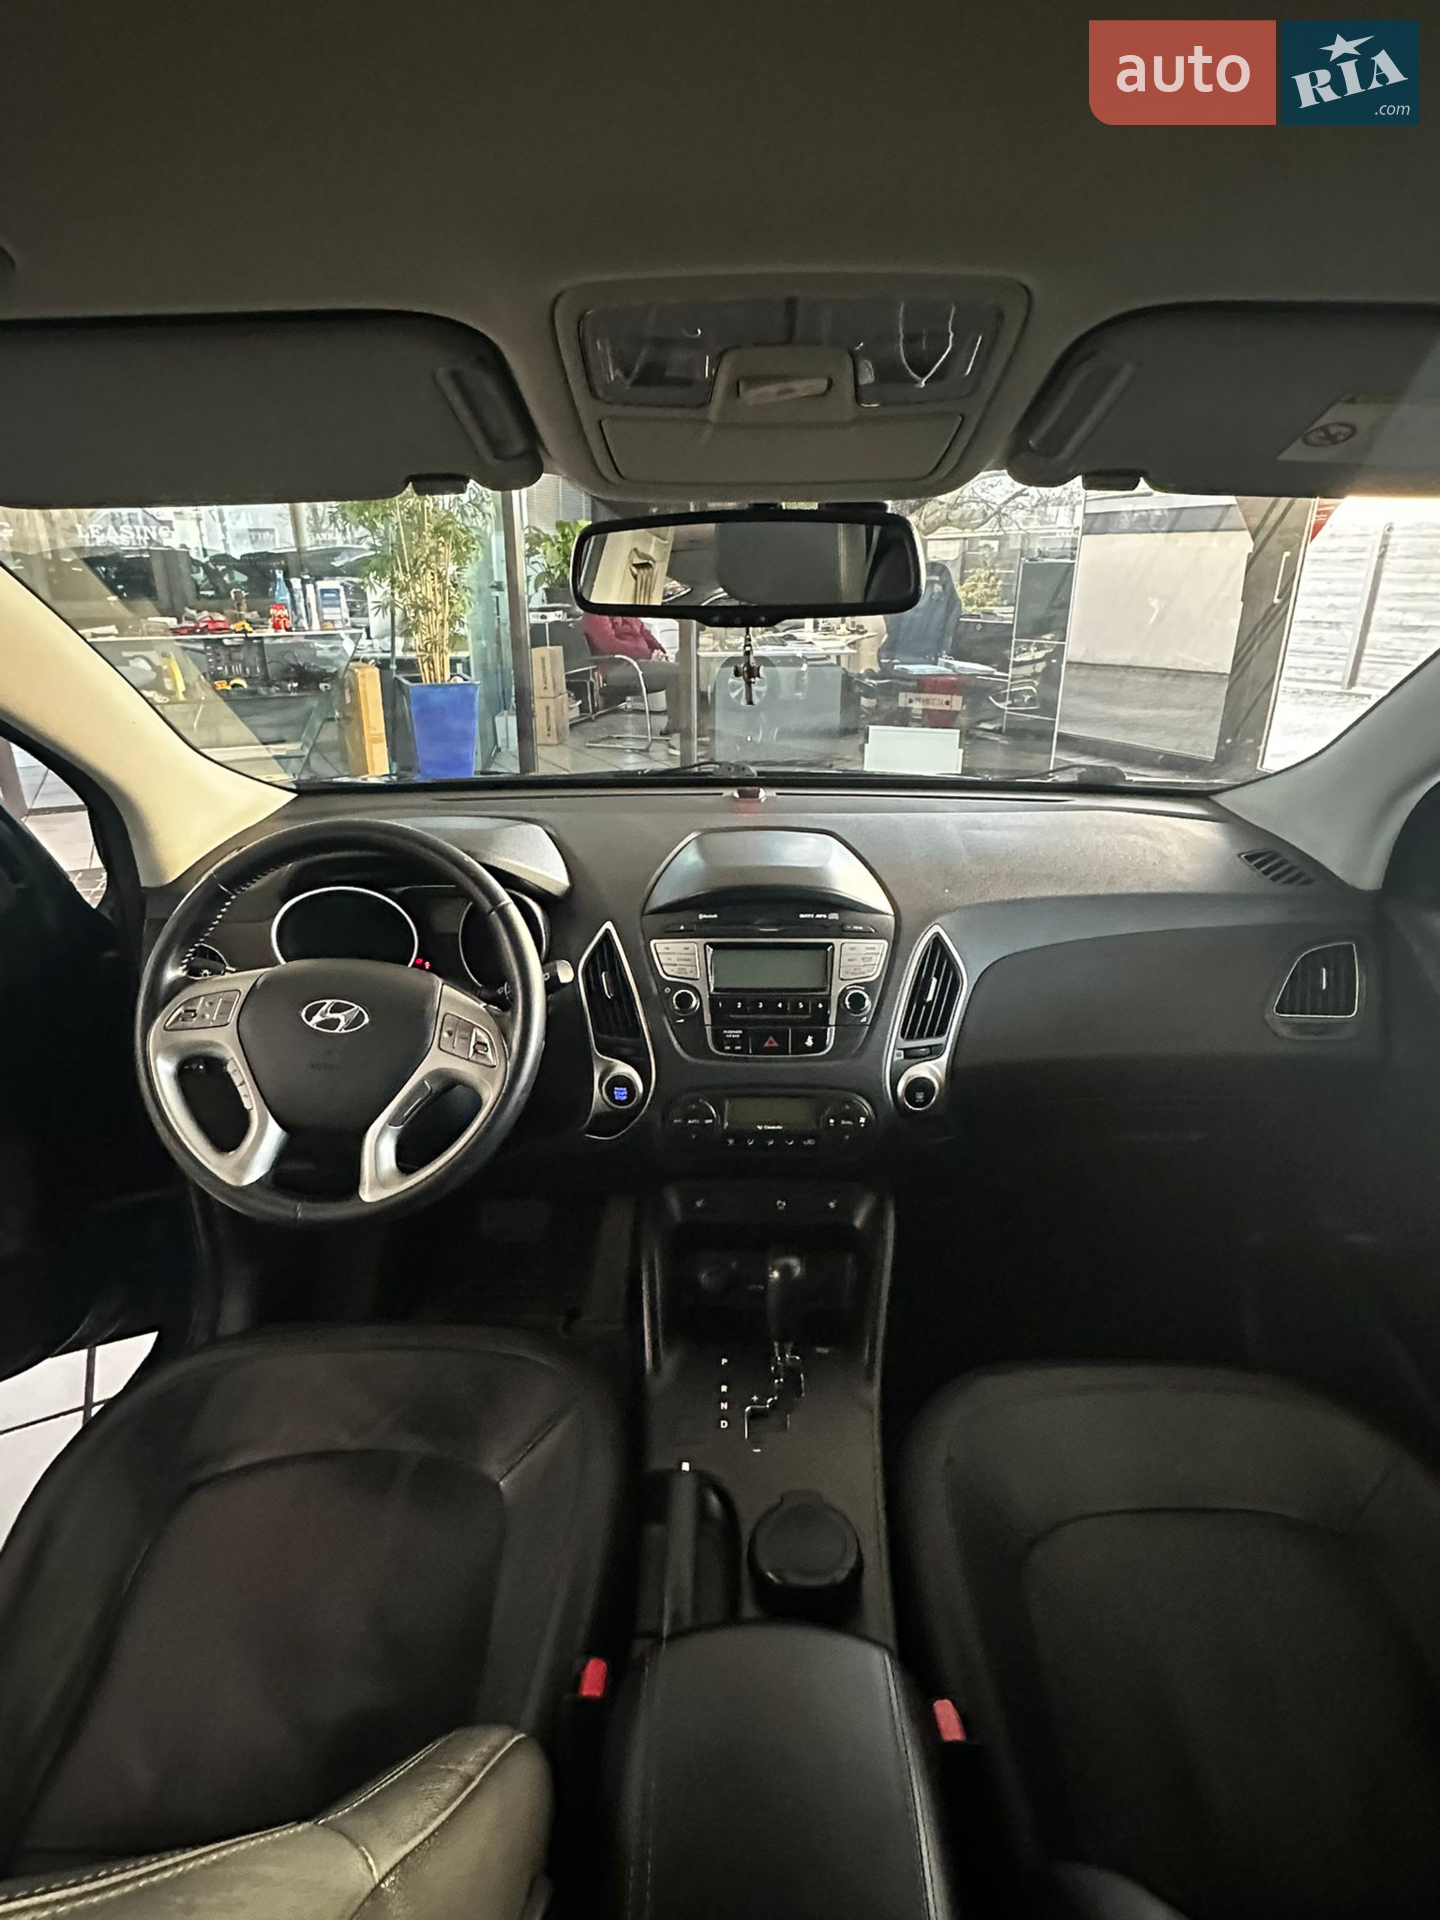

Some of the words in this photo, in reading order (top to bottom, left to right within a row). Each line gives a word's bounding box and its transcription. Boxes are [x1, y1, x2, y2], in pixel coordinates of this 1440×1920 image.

[75, 523, 174, 540] LEASING
[758, 1001, 763, 1009] 3
[721, 1357, 728, 1366] P
[720, 1384, 728, 1393] R
[720, 1401, 728, 1410] N
[720, 1419, 728, 1429] D
